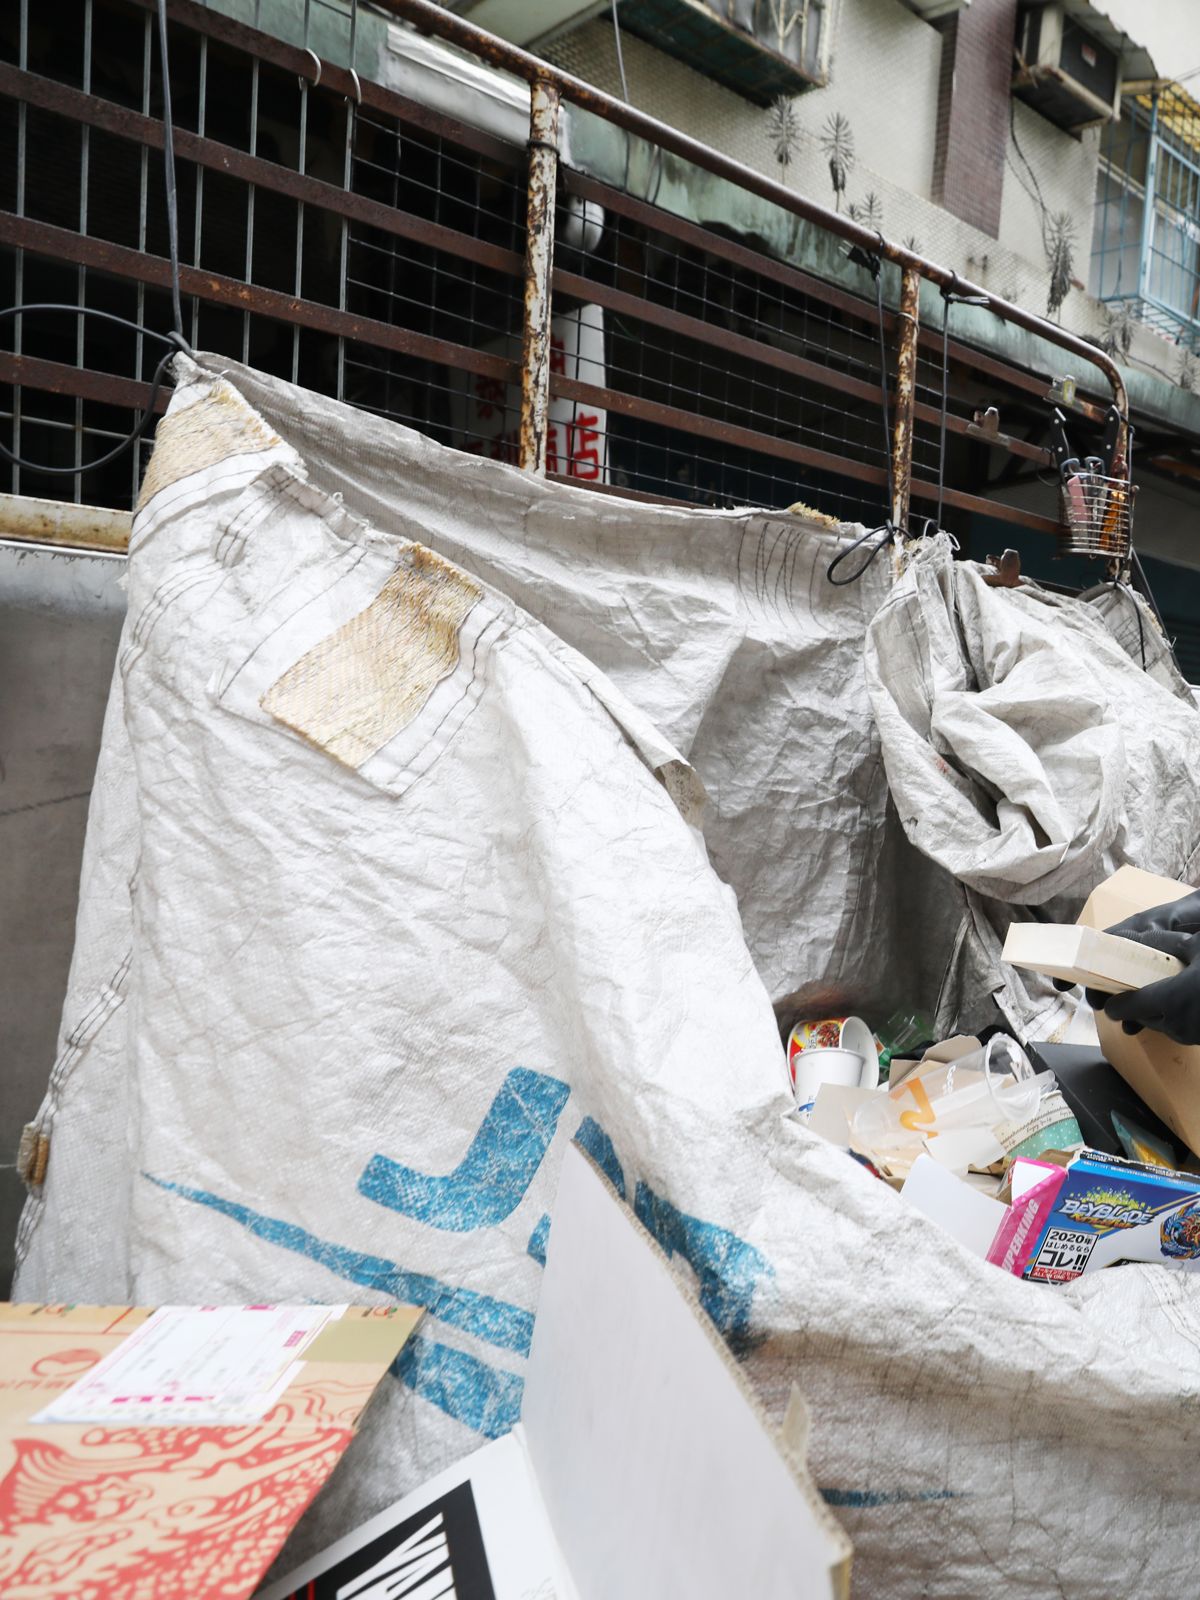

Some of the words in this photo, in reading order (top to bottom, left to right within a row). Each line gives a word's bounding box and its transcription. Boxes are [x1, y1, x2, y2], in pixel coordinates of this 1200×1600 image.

[1059, 1199, 1154, 1225] BEYBLADE
[1002, 1198, 1040, 1273] UPERKING
[1050, 1231, 1093, 1245] 2020年
[1045, 1241, 1090, 1253] はじめるなら
[1038, 1249, 1087, 1271] コレ!!
